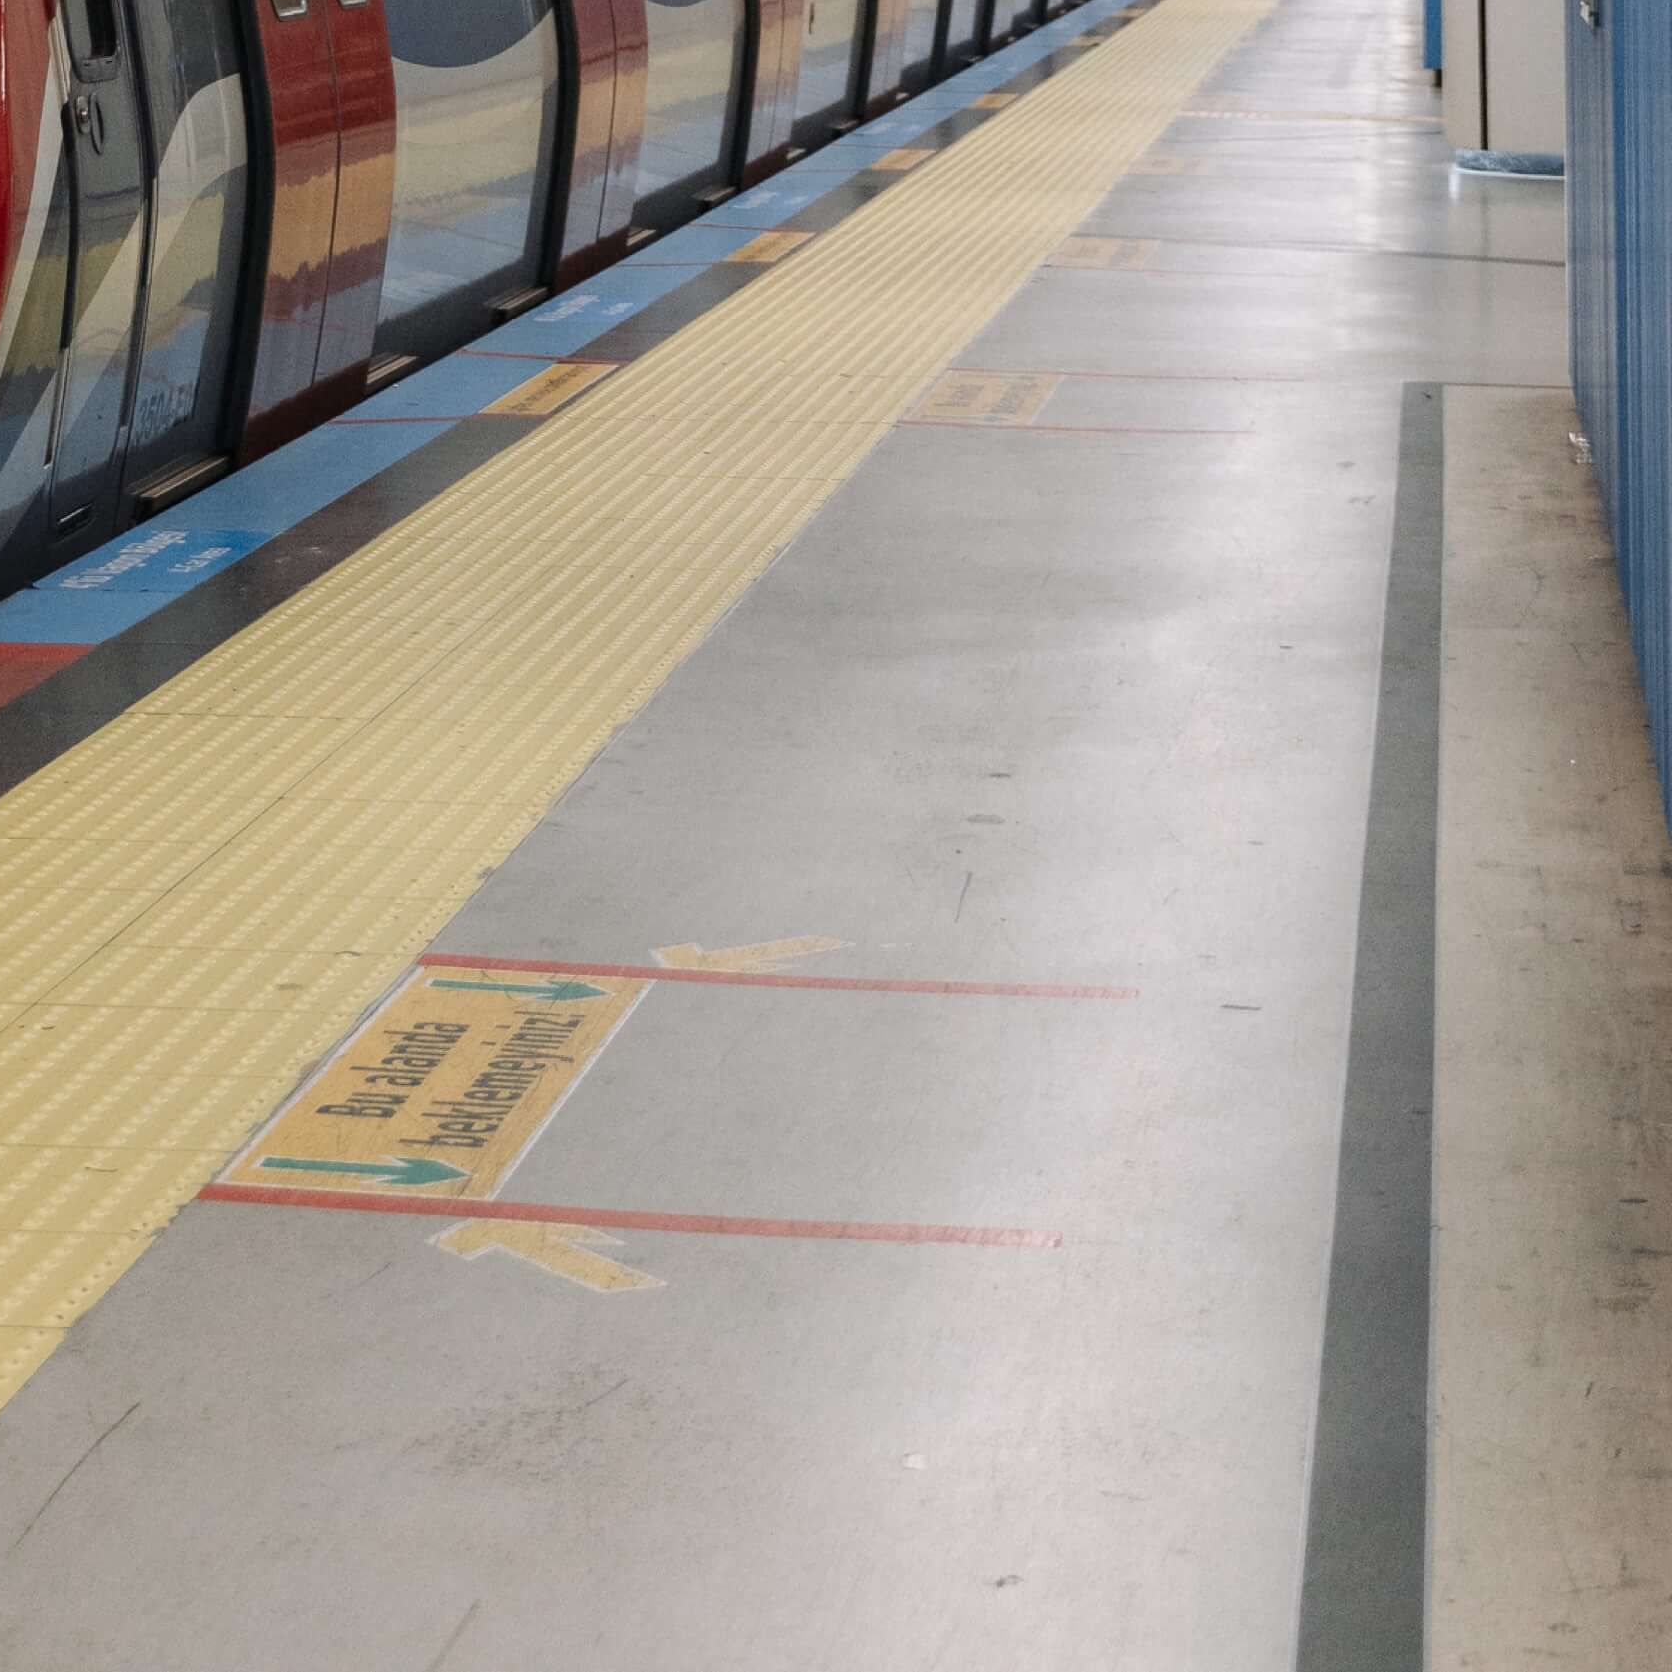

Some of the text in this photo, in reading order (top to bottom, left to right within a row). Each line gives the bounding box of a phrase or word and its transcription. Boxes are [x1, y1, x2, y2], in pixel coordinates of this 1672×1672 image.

[315, 1021, 470, 1120] Bu alanda
[398, 1010, 588, 1149] beklemeyiniz!
